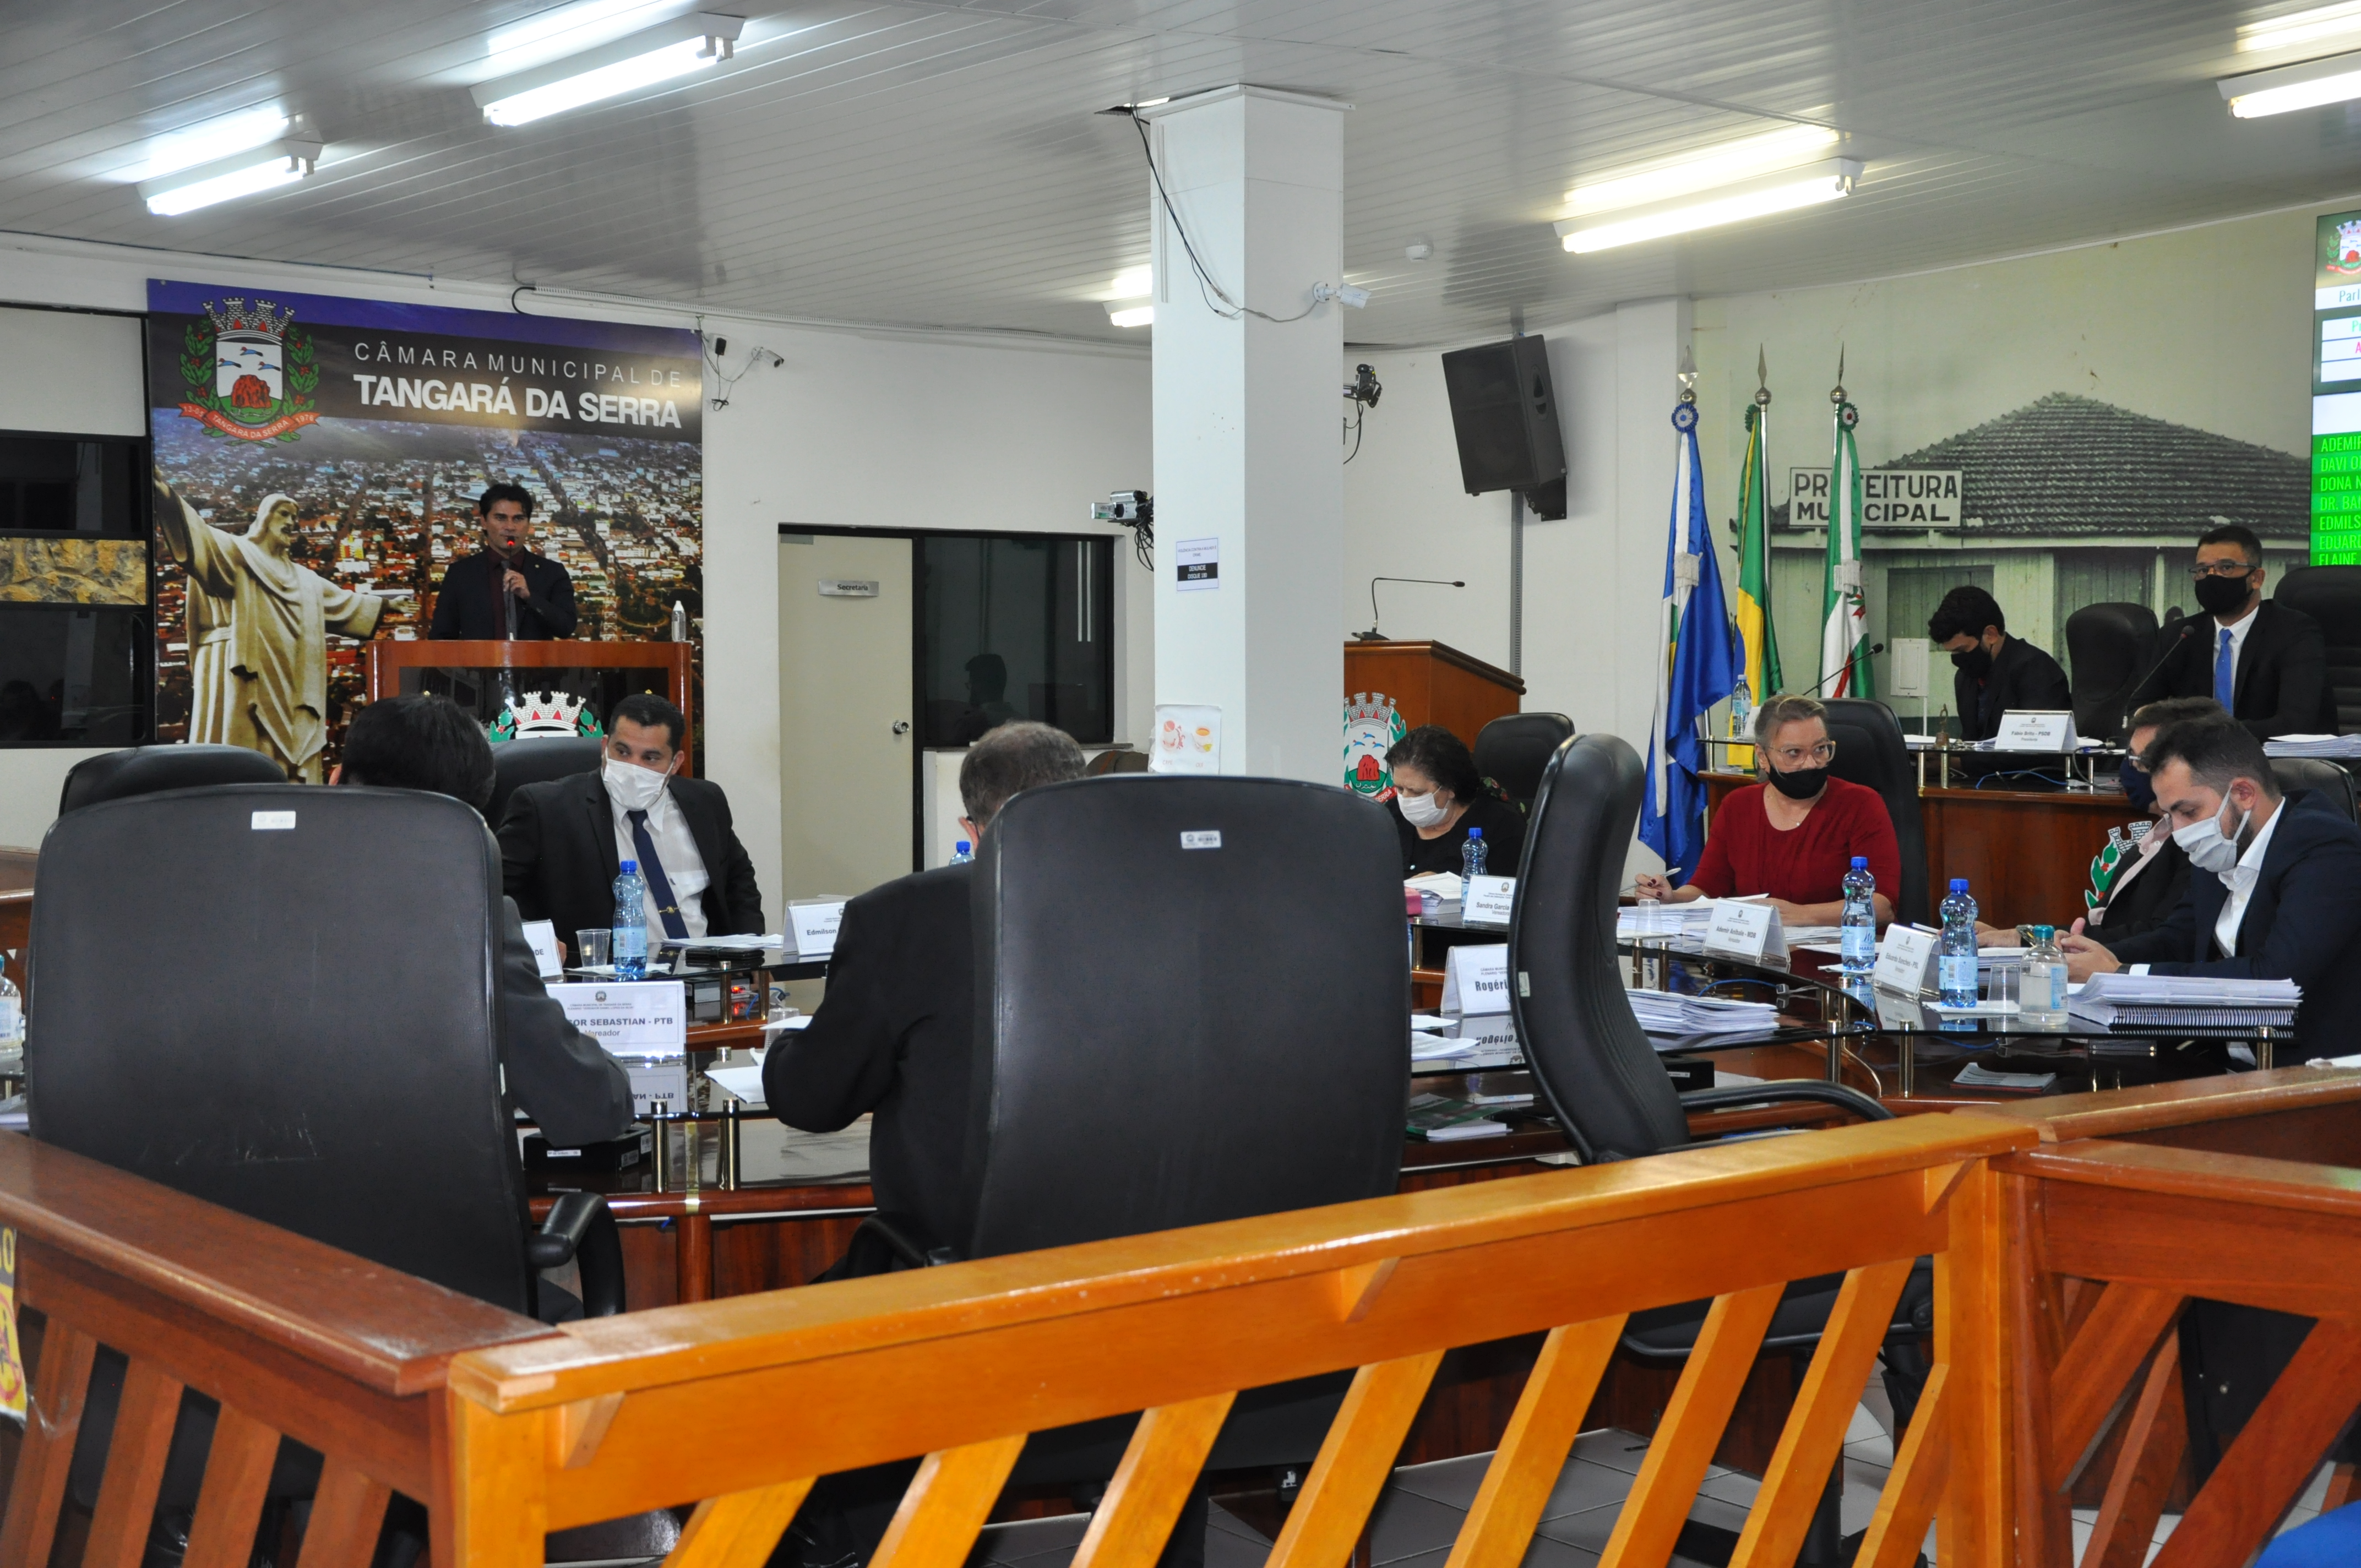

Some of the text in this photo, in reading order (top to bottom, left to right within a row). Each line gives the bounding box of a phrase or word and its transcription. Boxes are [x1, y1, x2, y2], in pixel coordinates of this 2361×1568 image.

[355, 341, 680, 388] CÂMARA MUNICIPAL DE
[353, 374, 682, 429] TANGARÁ DA SERRA
[183, 405, 205, 417] 13-05
[295, 414, 314, 423] 1976
[262, 420, 290, 437] SERRA
[2321, 456, 2347, 472] DAVI
[1794, 473, 1958, 498] PREITURA
[2320, 476, 2352, 491] DONA
[2320, 497, 2338, 511] DR.
[1797, 502, 1950, 522] MUCIPAL
[1475, 979, 1509, 992] Rogéri
[590, 1018, 646, 1026] SEBASTIAN
